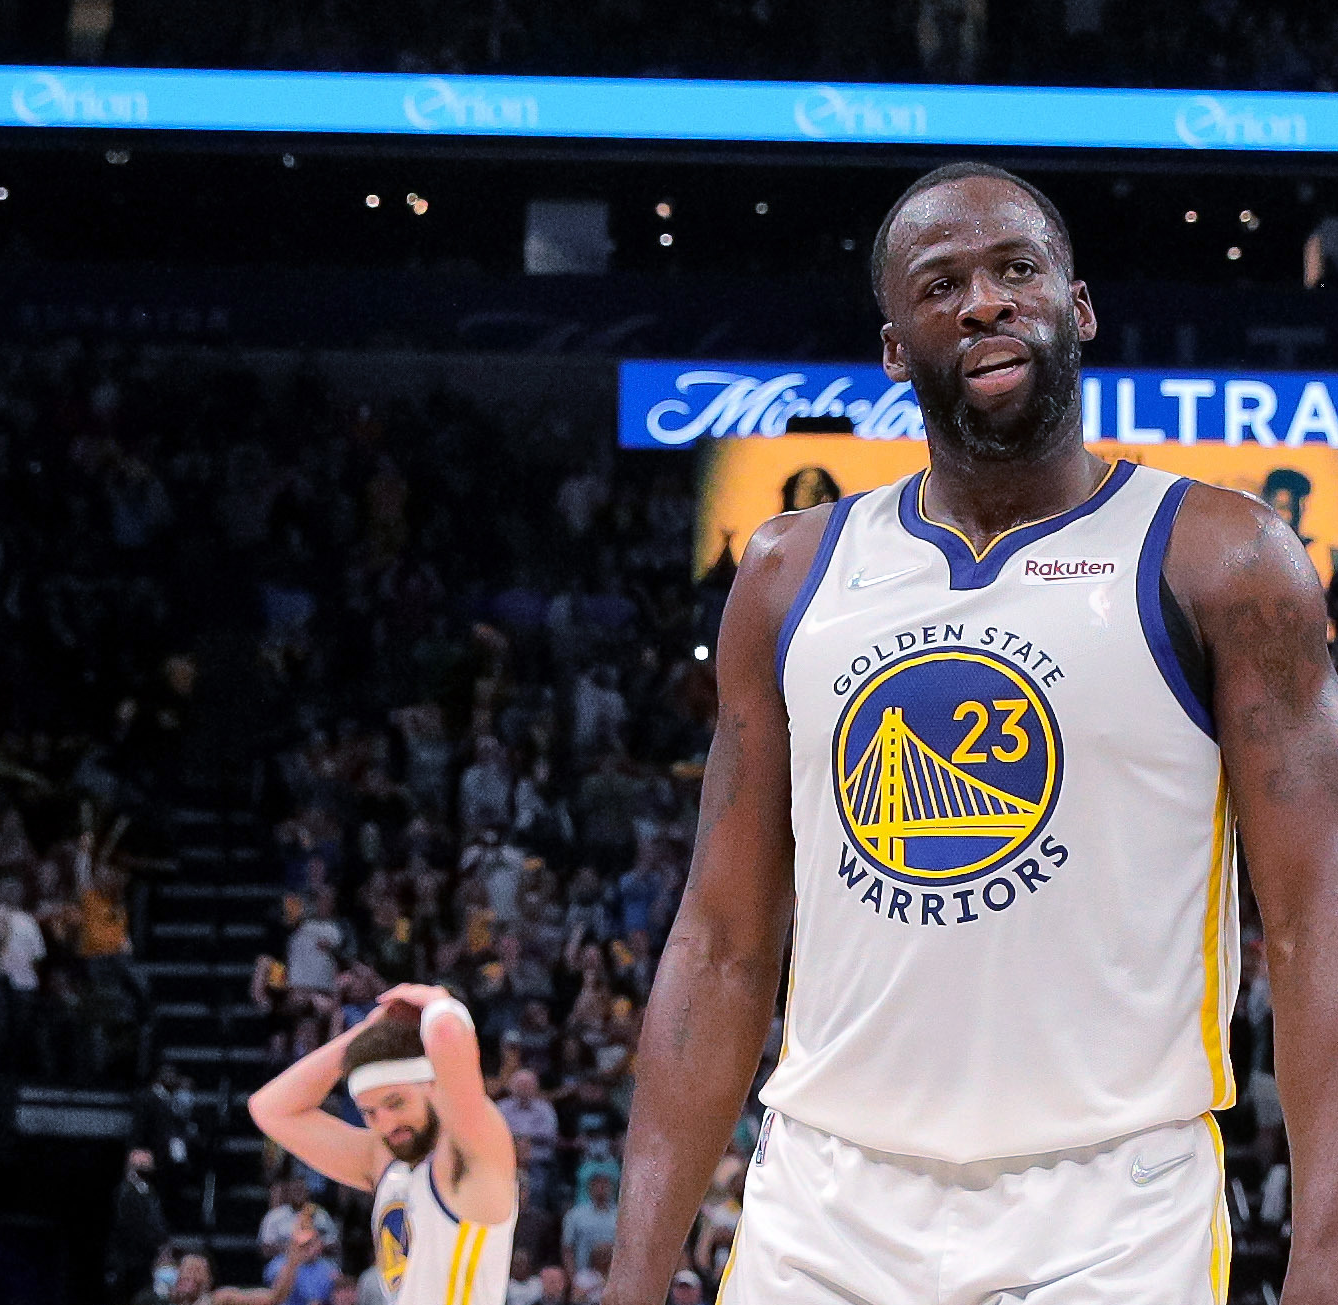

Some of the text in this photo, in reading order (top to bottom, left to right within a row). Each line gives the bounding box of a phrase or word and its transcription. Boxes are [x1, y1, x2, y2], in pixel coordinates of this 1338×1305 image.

[1024, 559, 1116, 577] Rakuten
[833, 624, 1066, 696] GOLDEN STATE
[951, 699, 1030, 764] 23
[837, 834, 1069, 926] WARRIORS
